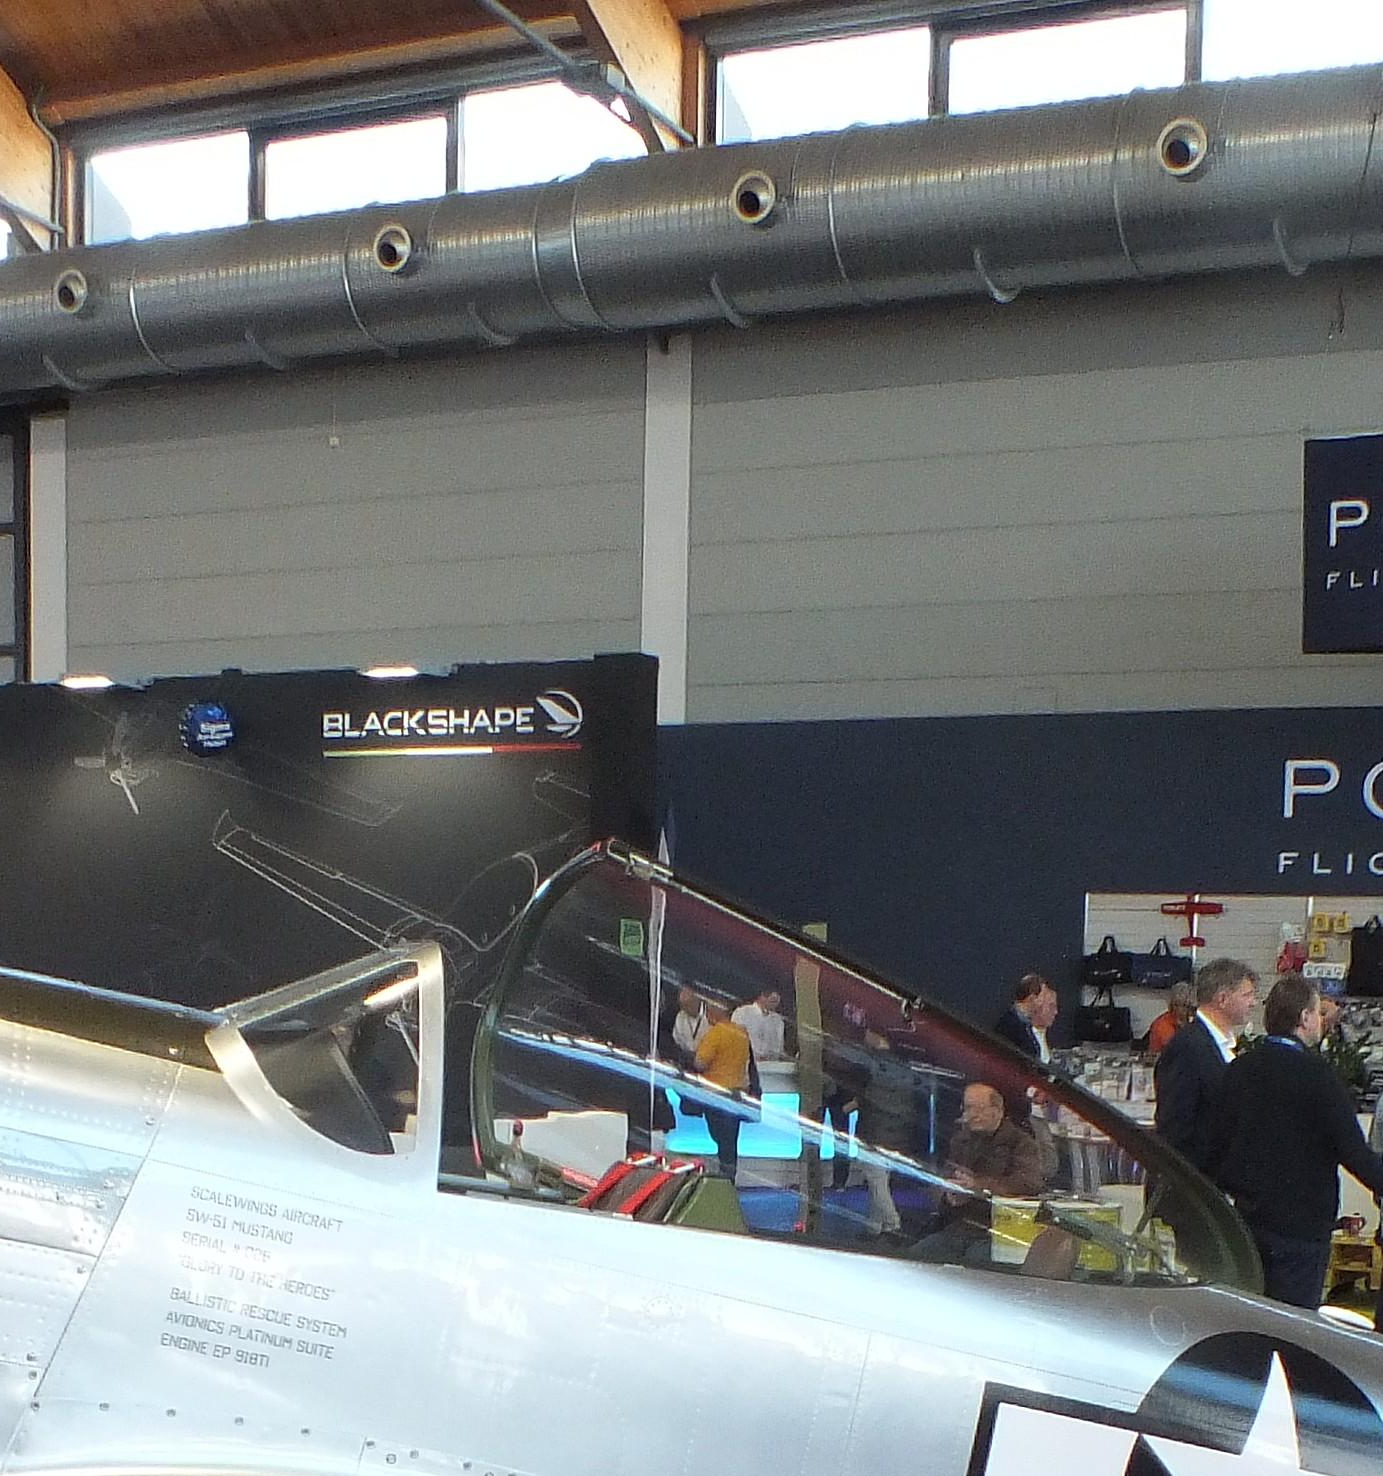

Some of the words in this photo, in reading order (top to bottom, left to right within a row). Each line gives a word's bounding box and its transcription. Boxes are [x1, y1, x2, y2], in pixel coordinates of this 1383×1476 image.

[322, 706, 534, 739] BLACKSHAPE
[191, 1186, 277, 1217] SCALEWINGS
[282, 1208, 343, 1232] AIRCRAFT
[182, 1231, 227, 1253] SERIAL
[232, 1220, 293, 1245] MUSTANG
[170, 1287, 237, 1314] BALLISTIC
[240, 1303, 292, 1327] RESCUE
[296, 1316, 347, 1338] SYSTEM
[160, 1332, 209, 1356] ENGINE
[213, 1344, 231, 1359] EP
[166, 1311, 225, 1335] AVIONICS
[229, 1325, 293, 1349] PLATINUM
[296, 1340, 334, 1360] SUITE
